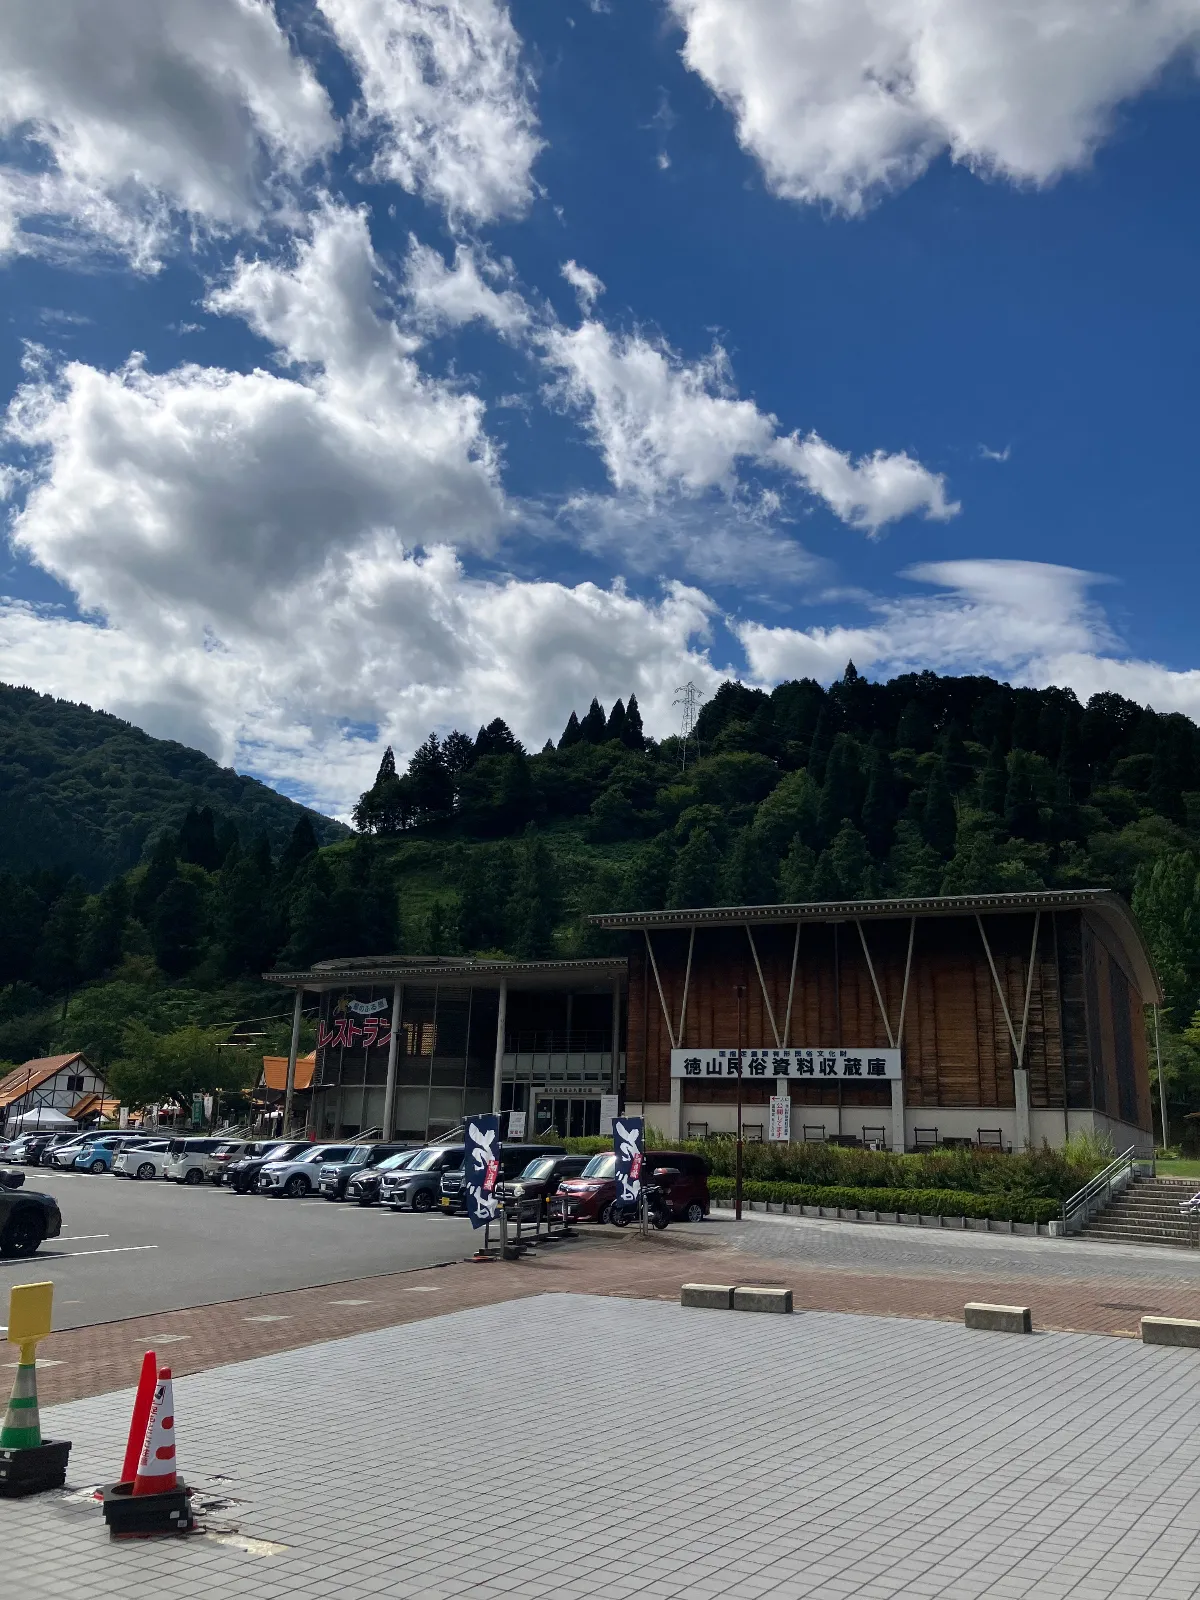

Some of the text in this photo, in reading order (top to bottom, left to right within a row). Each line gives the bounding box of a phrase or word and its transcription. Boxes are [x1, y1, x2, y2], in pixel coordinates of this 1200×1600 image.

[318, 1018, 392, 1048] レストラン
[684, 1058, 886, 1076] 徳山民俗資料収蔵庫
[776, 1103, 784, 1138] 公開してます
